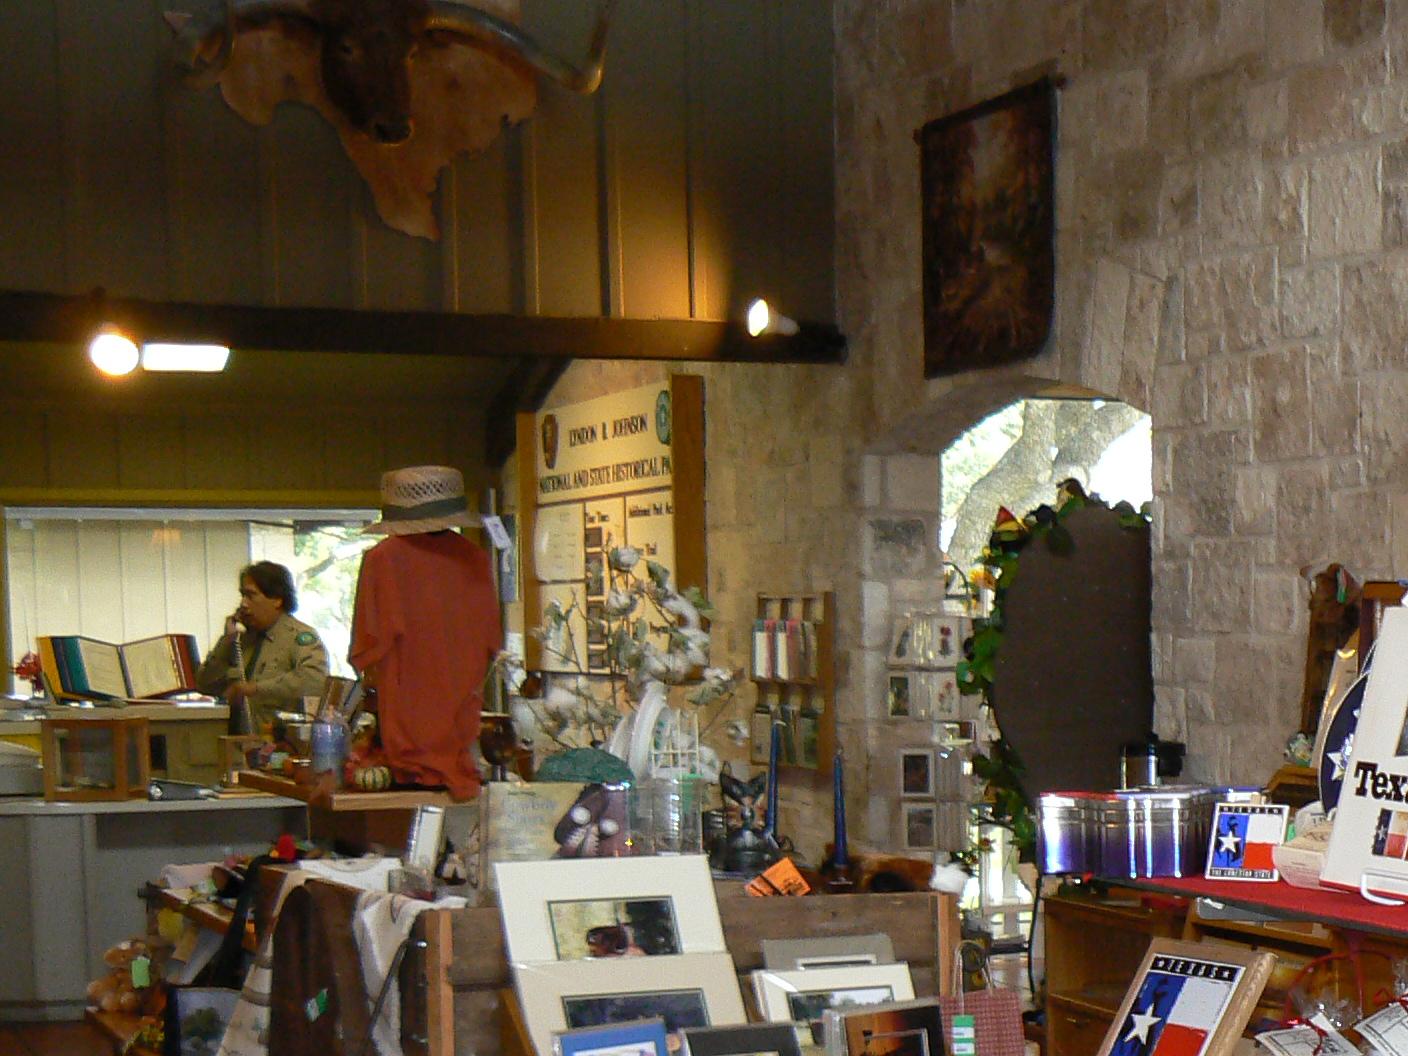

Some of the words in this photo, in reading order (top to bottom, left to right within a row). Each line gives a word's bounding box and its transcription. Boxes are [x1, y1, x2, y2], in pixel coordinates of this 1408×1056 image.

[612, 413, 648, 438] JOHNSON
[573, 469, 588, 488] AND
[589, 466, 610, 486] STATE
[611, 456, 657, 482] HISTORICAL
[1167, 958, 1219, 978] TEXAS
